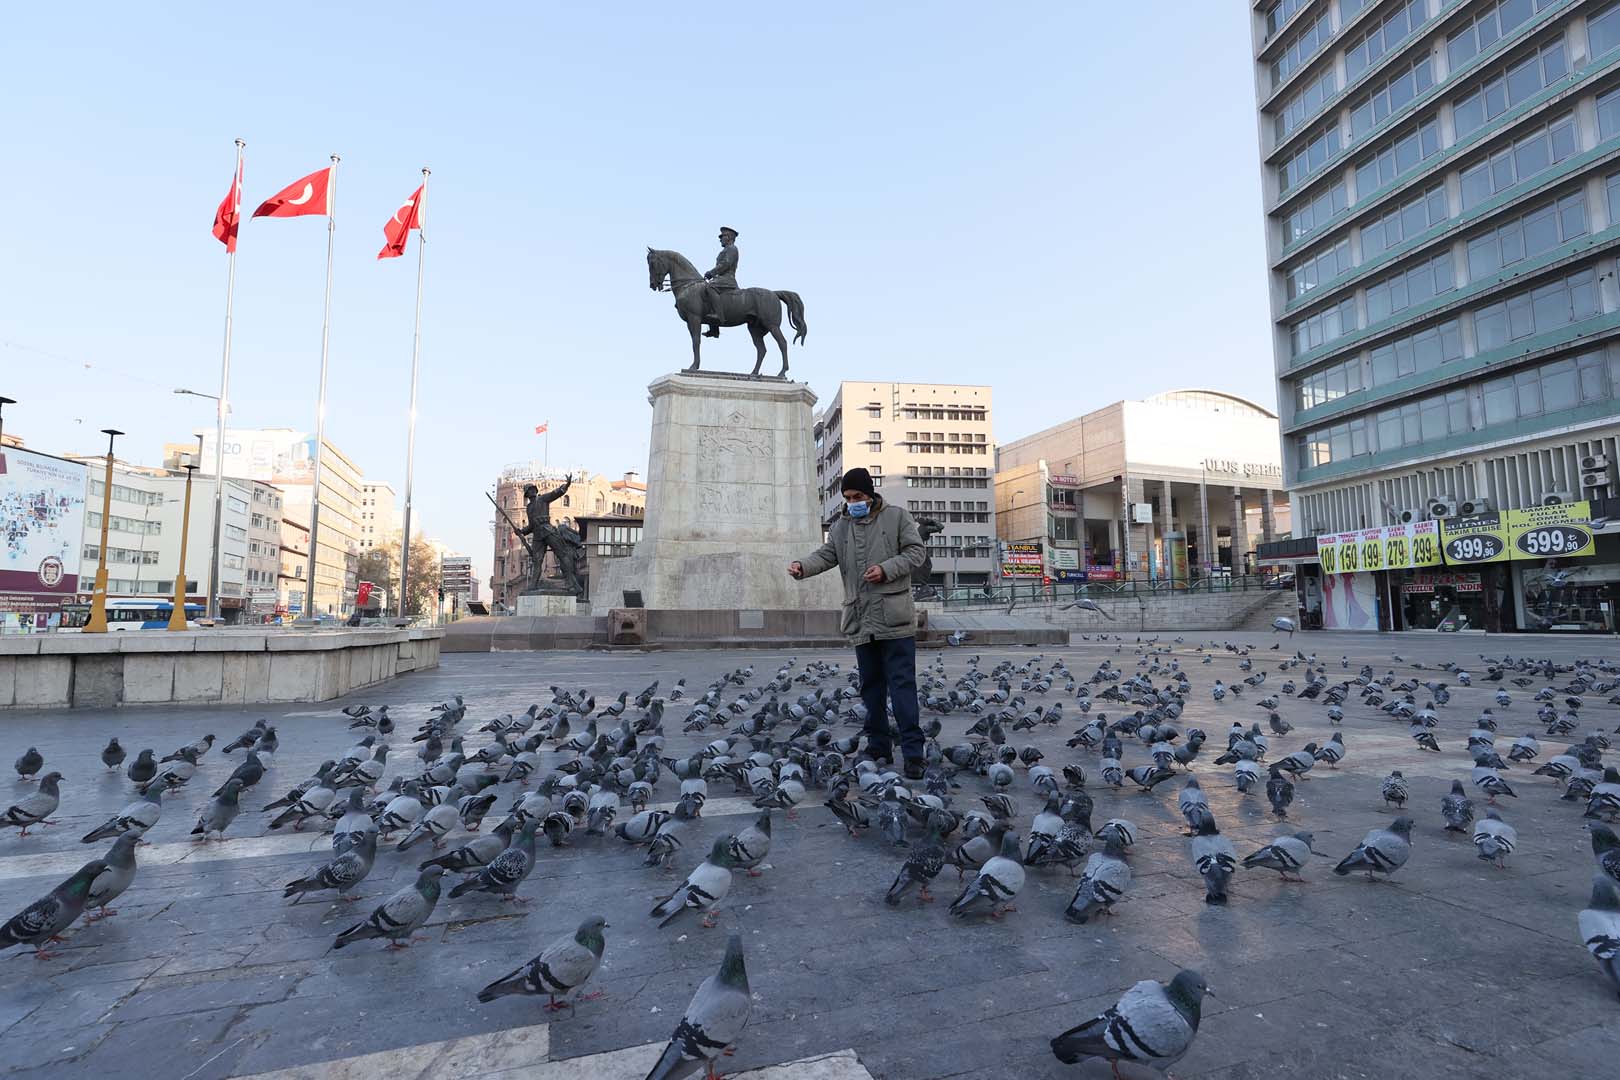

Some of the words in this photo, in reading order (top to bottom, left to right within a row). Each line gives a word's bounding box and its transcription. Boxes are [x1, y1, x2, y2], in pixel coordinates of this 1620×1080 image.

[1205, 458, 1238, 474] ULUS
[1520, 503, 1576, 514] DAMATLIK
[1320, 546, 1334, 572] 100
[1340, 544, 1357, 570] 150
[1362, 543, 1379, 568] 199
[1387, 540, 1404, 566] 279
[1413, 537, 1432, 563] 299
